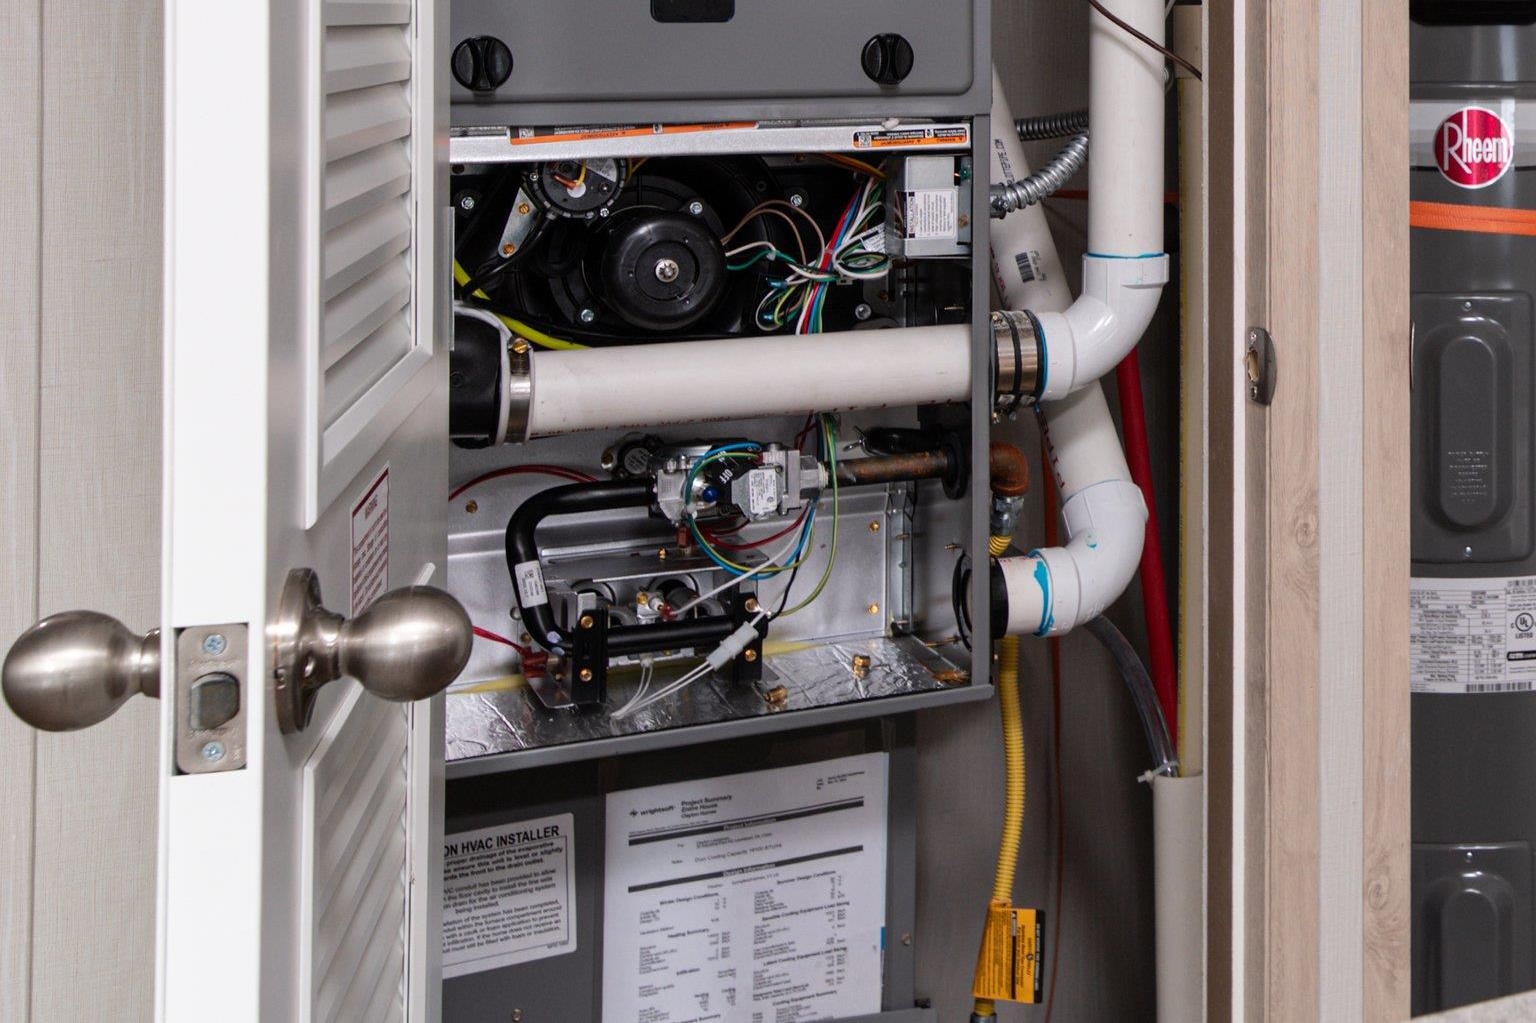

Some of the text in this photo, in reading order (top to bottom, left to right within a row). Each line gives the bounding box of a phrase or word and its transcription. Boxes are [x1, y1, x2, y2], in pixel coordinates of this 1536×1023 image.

[1443, 109, 1508, 174] Rheem
[718, 469, 733, 485] OFF
[681, 795, 732, 807] Project Summary
[640, 805, 674, 816] wrightsoft
[461, 837, 493, 854] HVAC
[496, 825, 560, 847] INSTALLER
